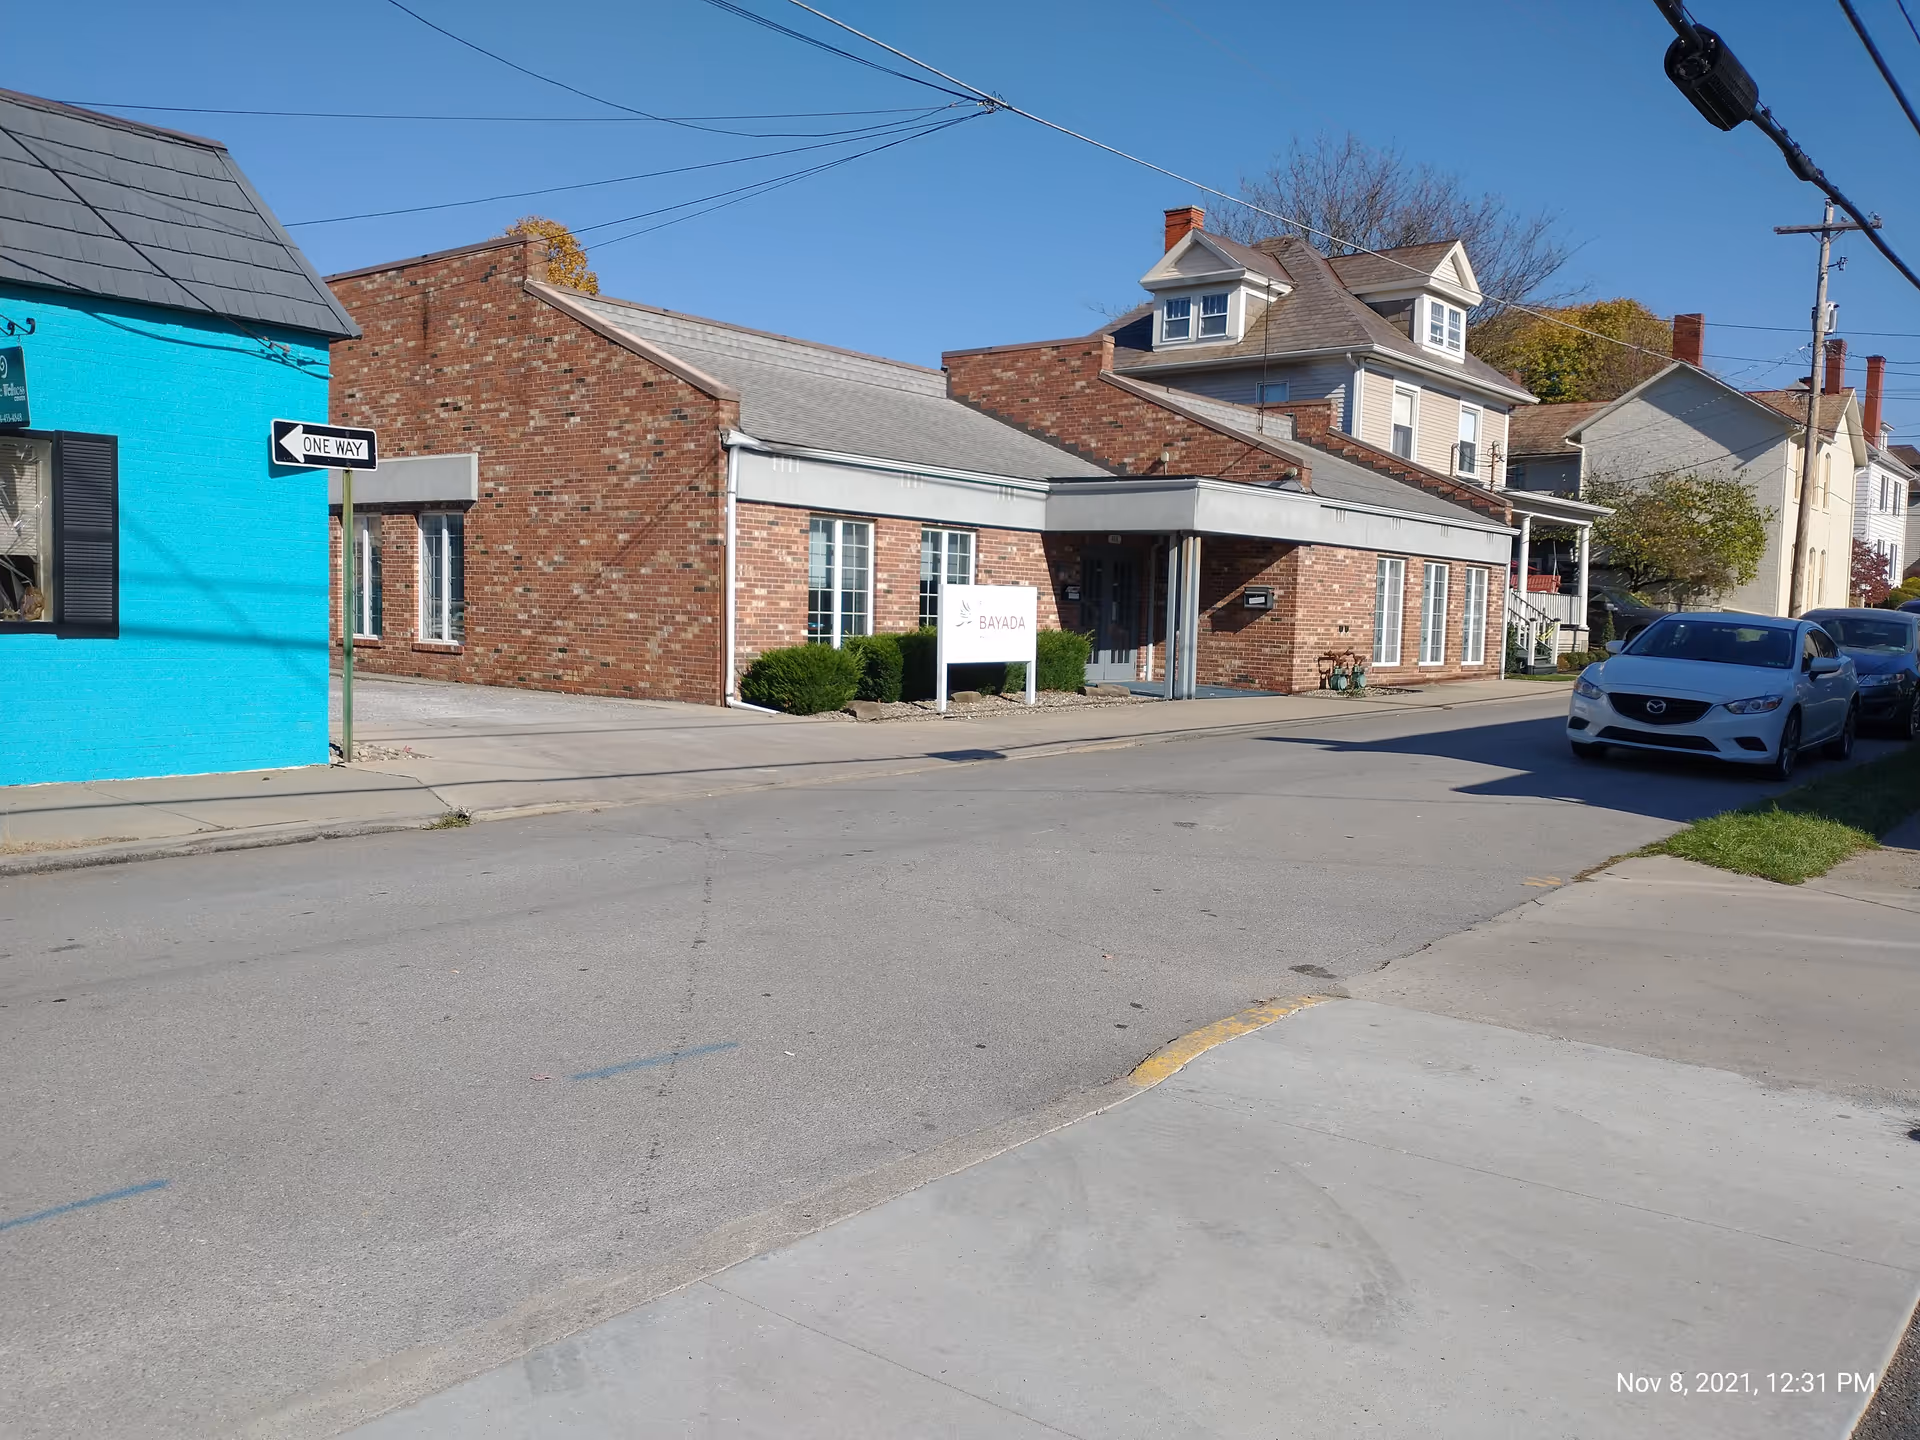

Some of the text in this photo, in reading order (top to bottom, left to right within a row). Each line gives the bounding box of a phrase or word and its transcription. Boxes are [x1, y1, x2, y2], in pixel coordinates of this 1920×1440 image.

[303, 436, 363, 457] ONE WAY
[979, 615, 1026, 630] BAYADA
